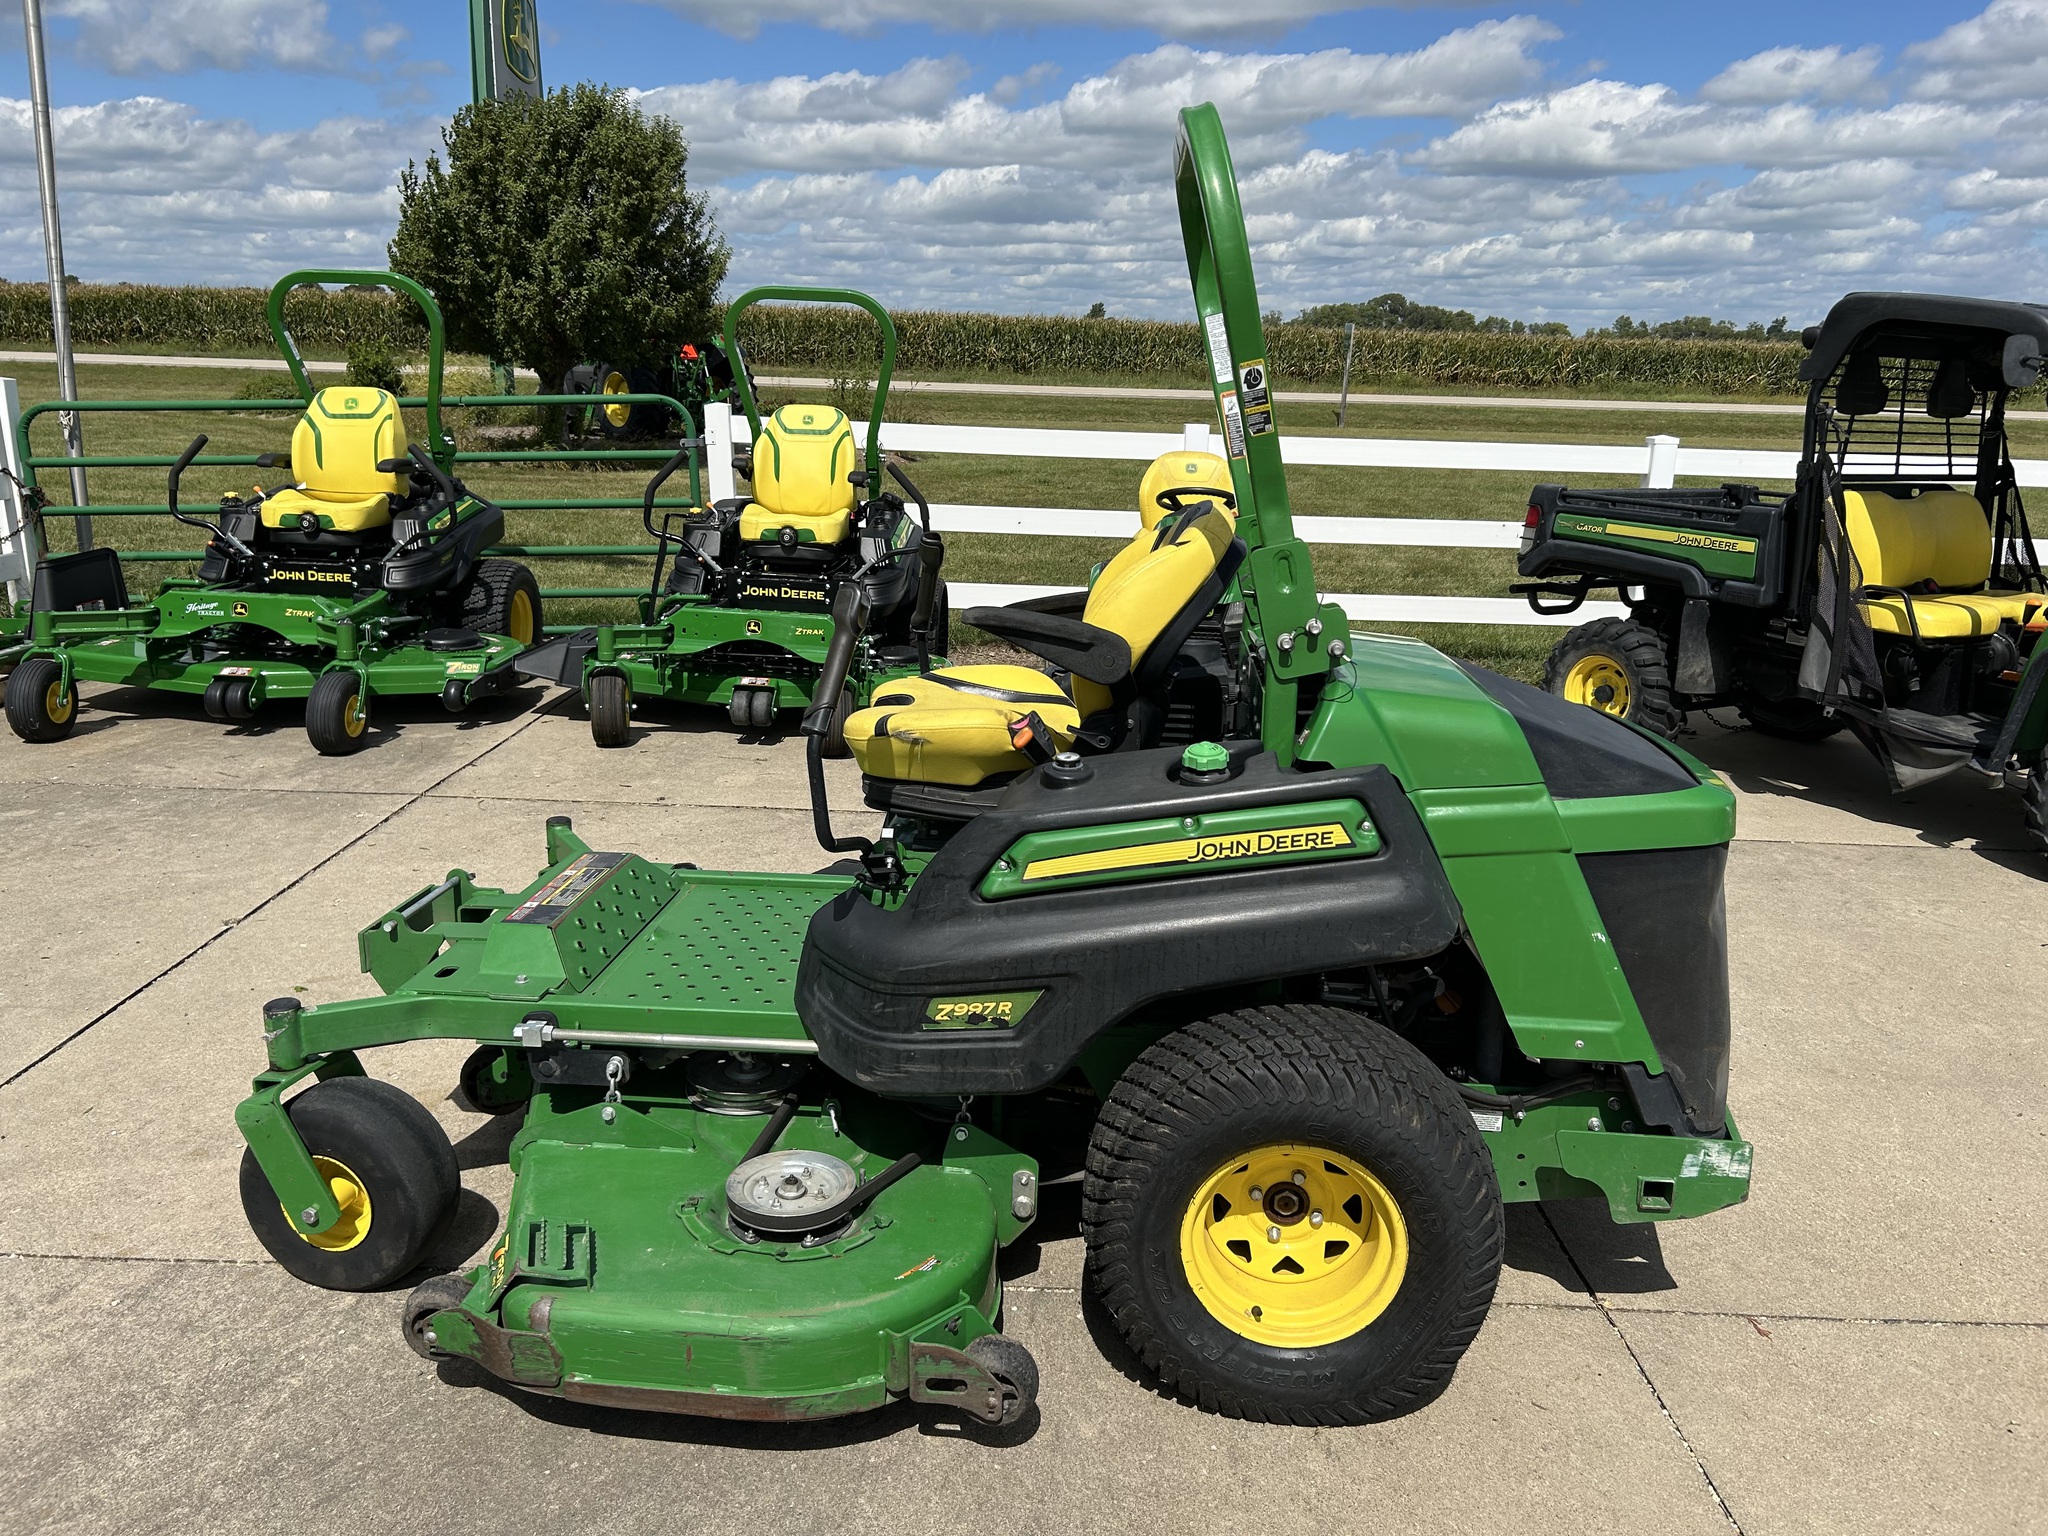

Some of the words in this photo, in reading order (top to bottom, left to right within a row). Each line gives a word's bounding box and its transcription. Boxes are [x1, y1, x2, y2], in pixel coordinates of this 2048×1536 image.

[1576, 523, 1603, 534] GATOR
[1673, 534, 1702, 547] JOHN
[1703, 537, 1739, 552] DEERE
[269, 568, 305, 581] JOHN
[307, 569, 352, 583] DEERE
[742, 585, 778, 597] JOHN
[781, 587, 825, 600] DEERE
[185, 602, 219, 614] Heritage
[285, 608, 315, 617] ZTRAK
[795, 627, 824, 635] ZTRAK
[1187, 839, 1252, 861] JOHN
[1257, 831, 1335, 852] DEERE
[1242, 1363, 1337, 1388] MULTI
